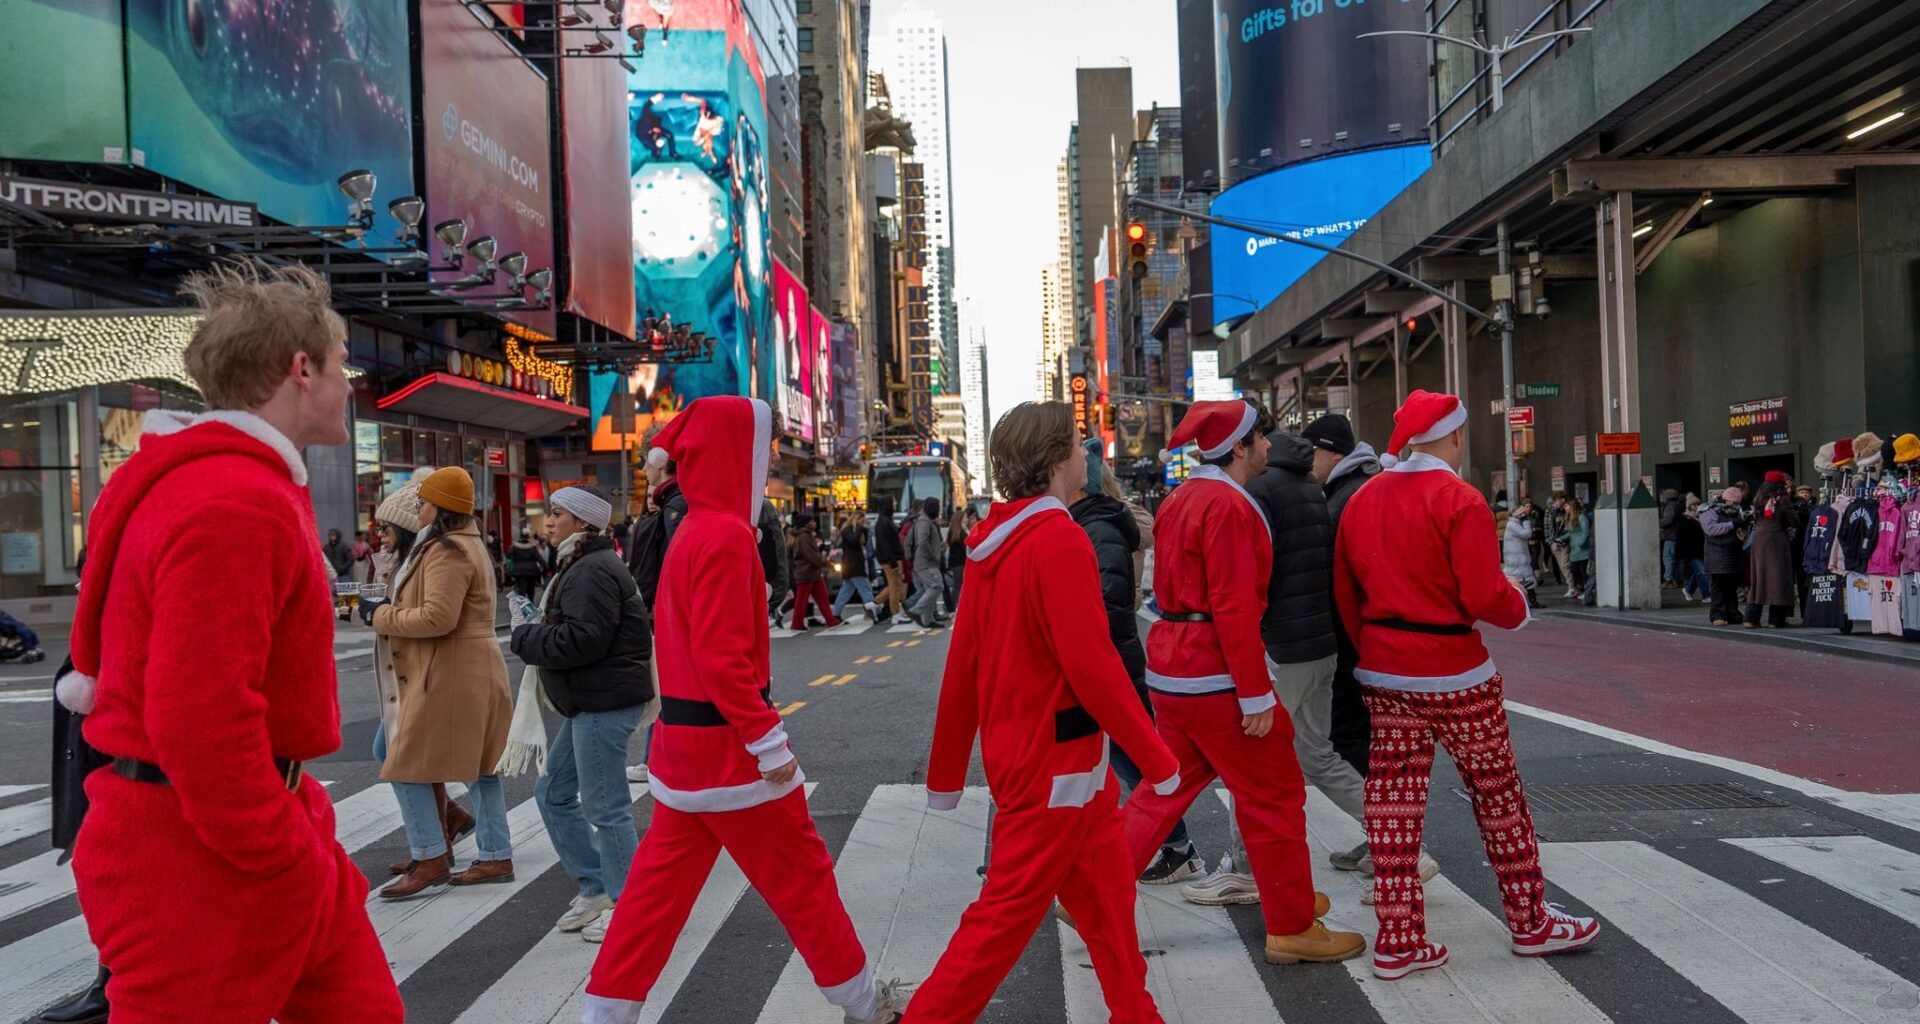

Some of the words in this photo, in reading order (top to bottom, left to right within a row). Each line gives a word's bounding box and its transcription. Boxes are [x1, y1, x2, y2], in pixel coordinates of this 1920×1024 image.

[1241, 8, 1286, 43] Gifts
[1290, 0, 1323, 21] for
[460, 119, 538, 193] GEMINI.COM
[515, 200, 545, 227] CRYPTO
[905, 163, 925, 268] MADAME
[1279, 230, 1302, 242] ORE
[1303, 227, 1315, 238] OF
[1316, 220, 1352, 235] WHAT'S
[1527, 384, 1559, 397] Broadway
[1073, 393, 1087, 438] REGA
[1730, 406, 1743, 414] Times
[1768, 400, 1783, 408] Street
[1811, 526, 1827, 538] NY
[1818, 581, 1831, 589] YOU
[1815, 594, 1832, 602] FUCK
